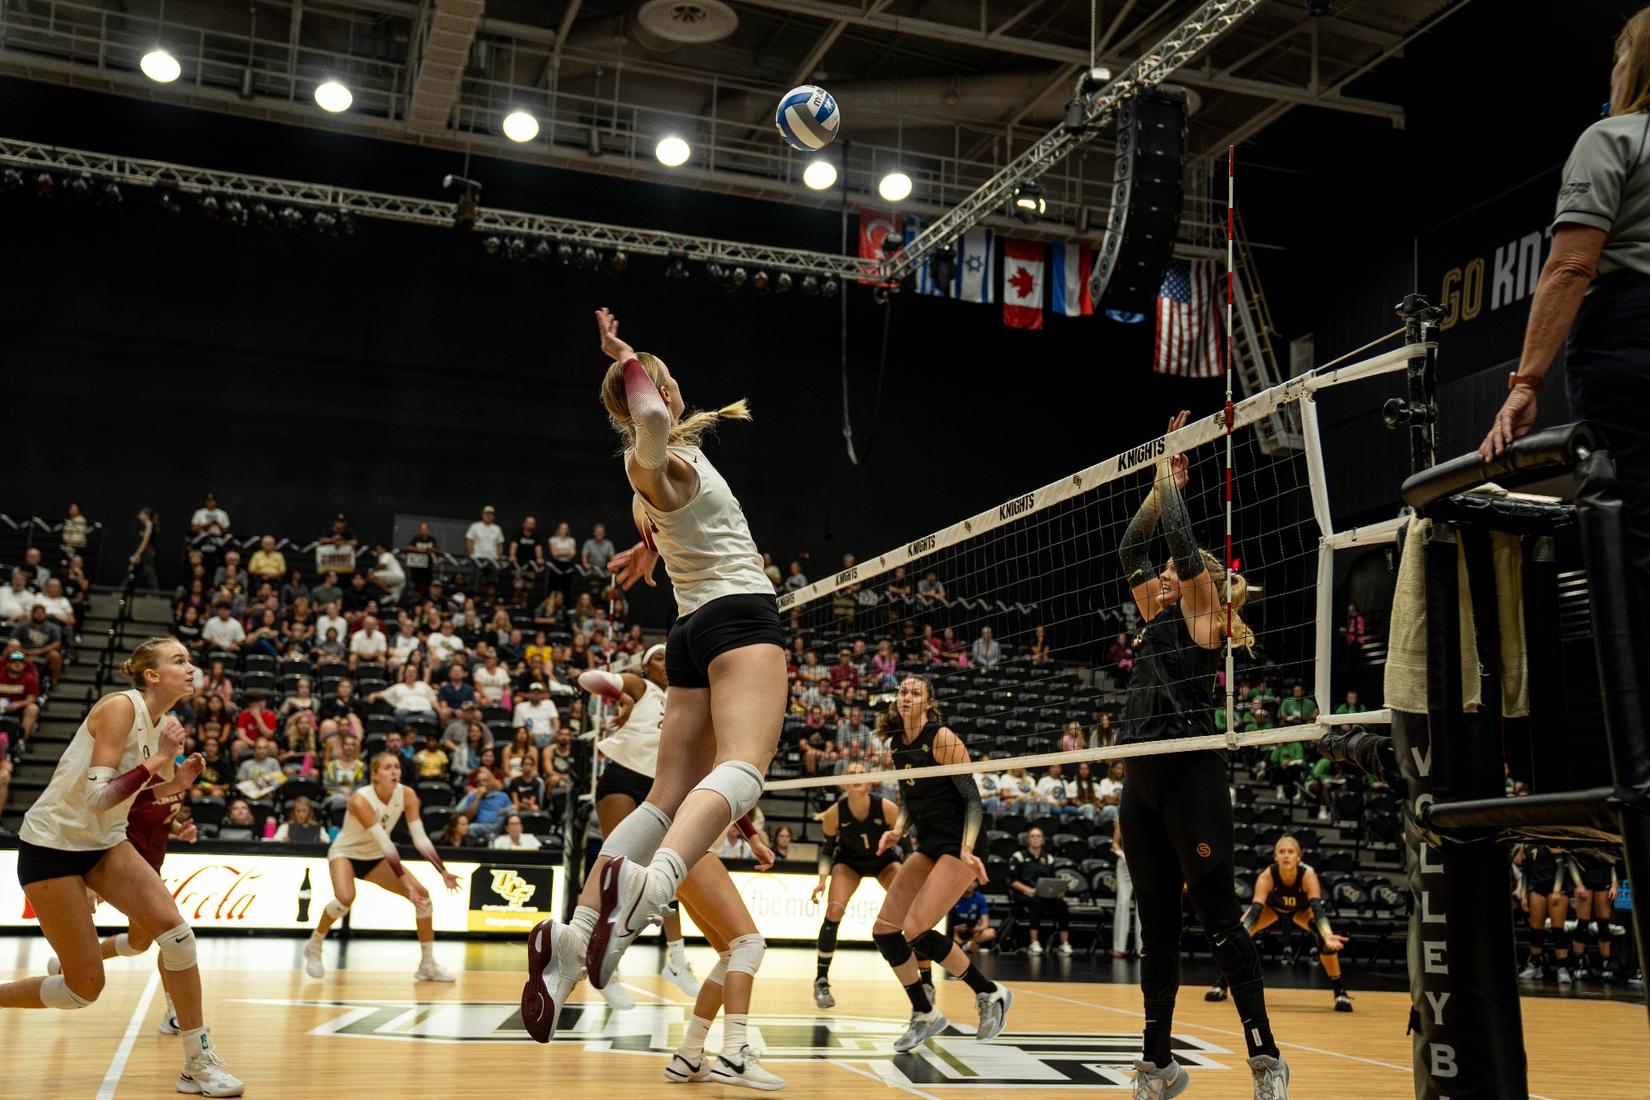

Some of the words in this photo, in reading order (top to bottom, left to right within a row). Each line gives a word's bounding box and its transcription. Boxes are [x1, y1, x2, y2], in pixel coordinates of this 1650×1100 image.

[1440, 257, 1485, 332] GO
[1491, 224, 1552, 311] KN
[1117, 437, 1165, 472] KNIGHTS
[999, 493, 1034, 521] KNIGHTS
[907, 535, 936, 558] KNIGHTS
[834, 567, 858, 587] KNIGHTS
[489, 869, 536, 907] UCF
[1282, 895, 1297, 907] 10
[785, 896, 879, 924] morage
[1410, 746, 1458, 1100] VLLEYB
